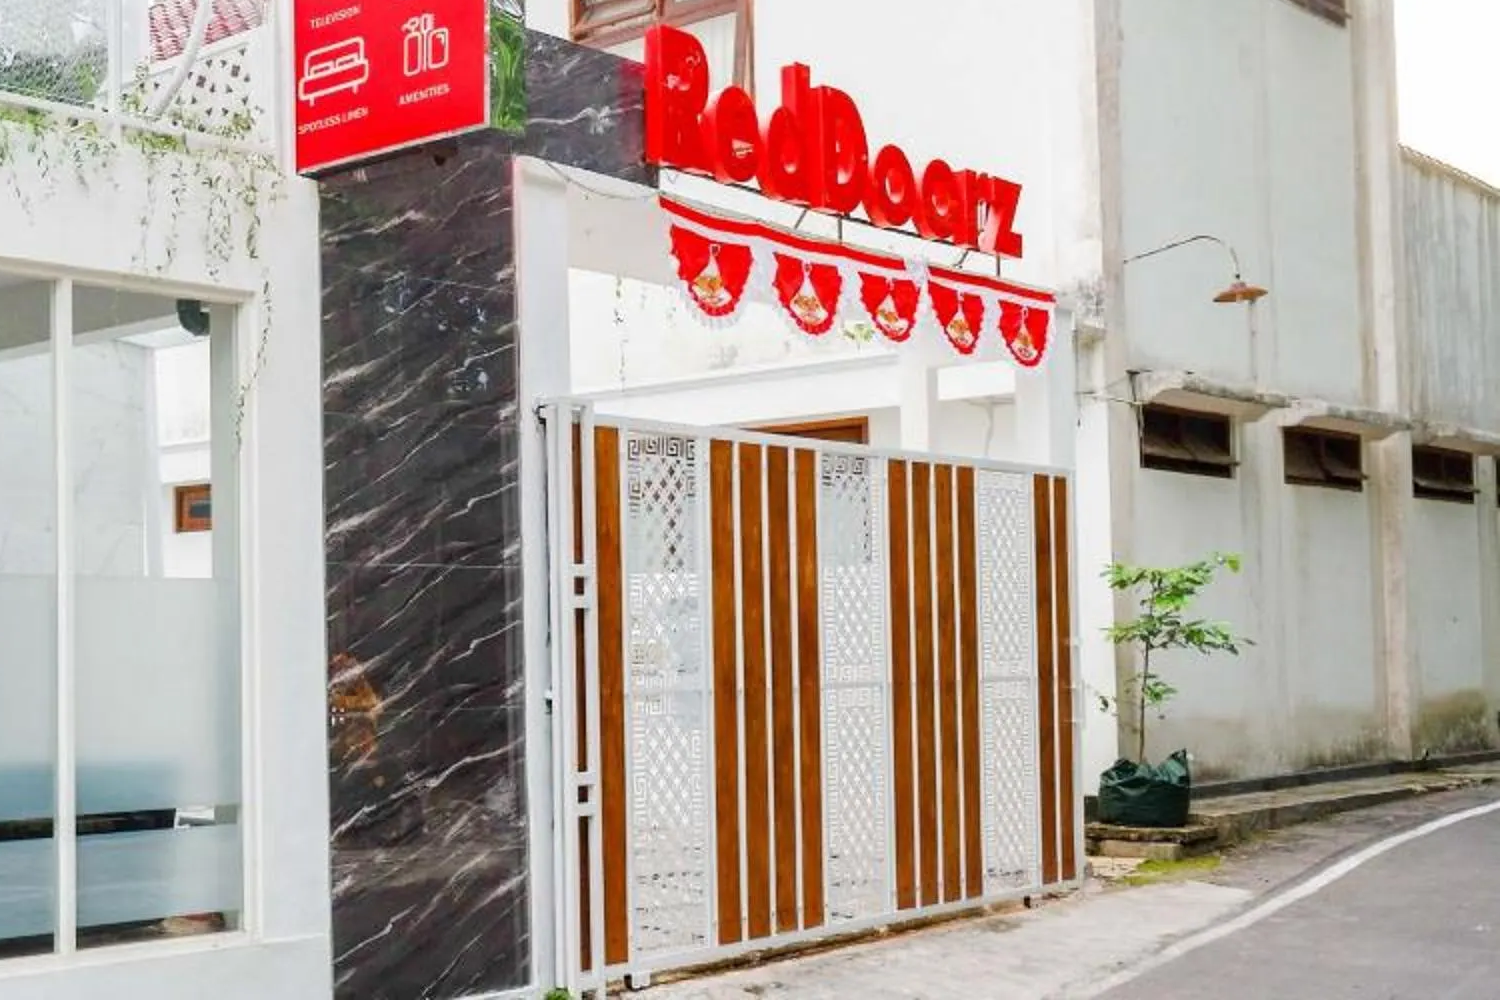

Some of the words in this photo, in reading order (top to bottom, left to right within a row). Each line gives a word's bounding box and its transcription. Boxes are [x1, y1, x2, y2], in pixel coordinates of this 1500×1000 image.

[309, 4, 361, 29] TELEVISION
[398, 83, 451, 106] AMENITIES
[297, 113, 341, 135] SPOTLESS
[341, 105, 369, 124] LINEN
[645, 25, 1023, 259] RedDoorz
